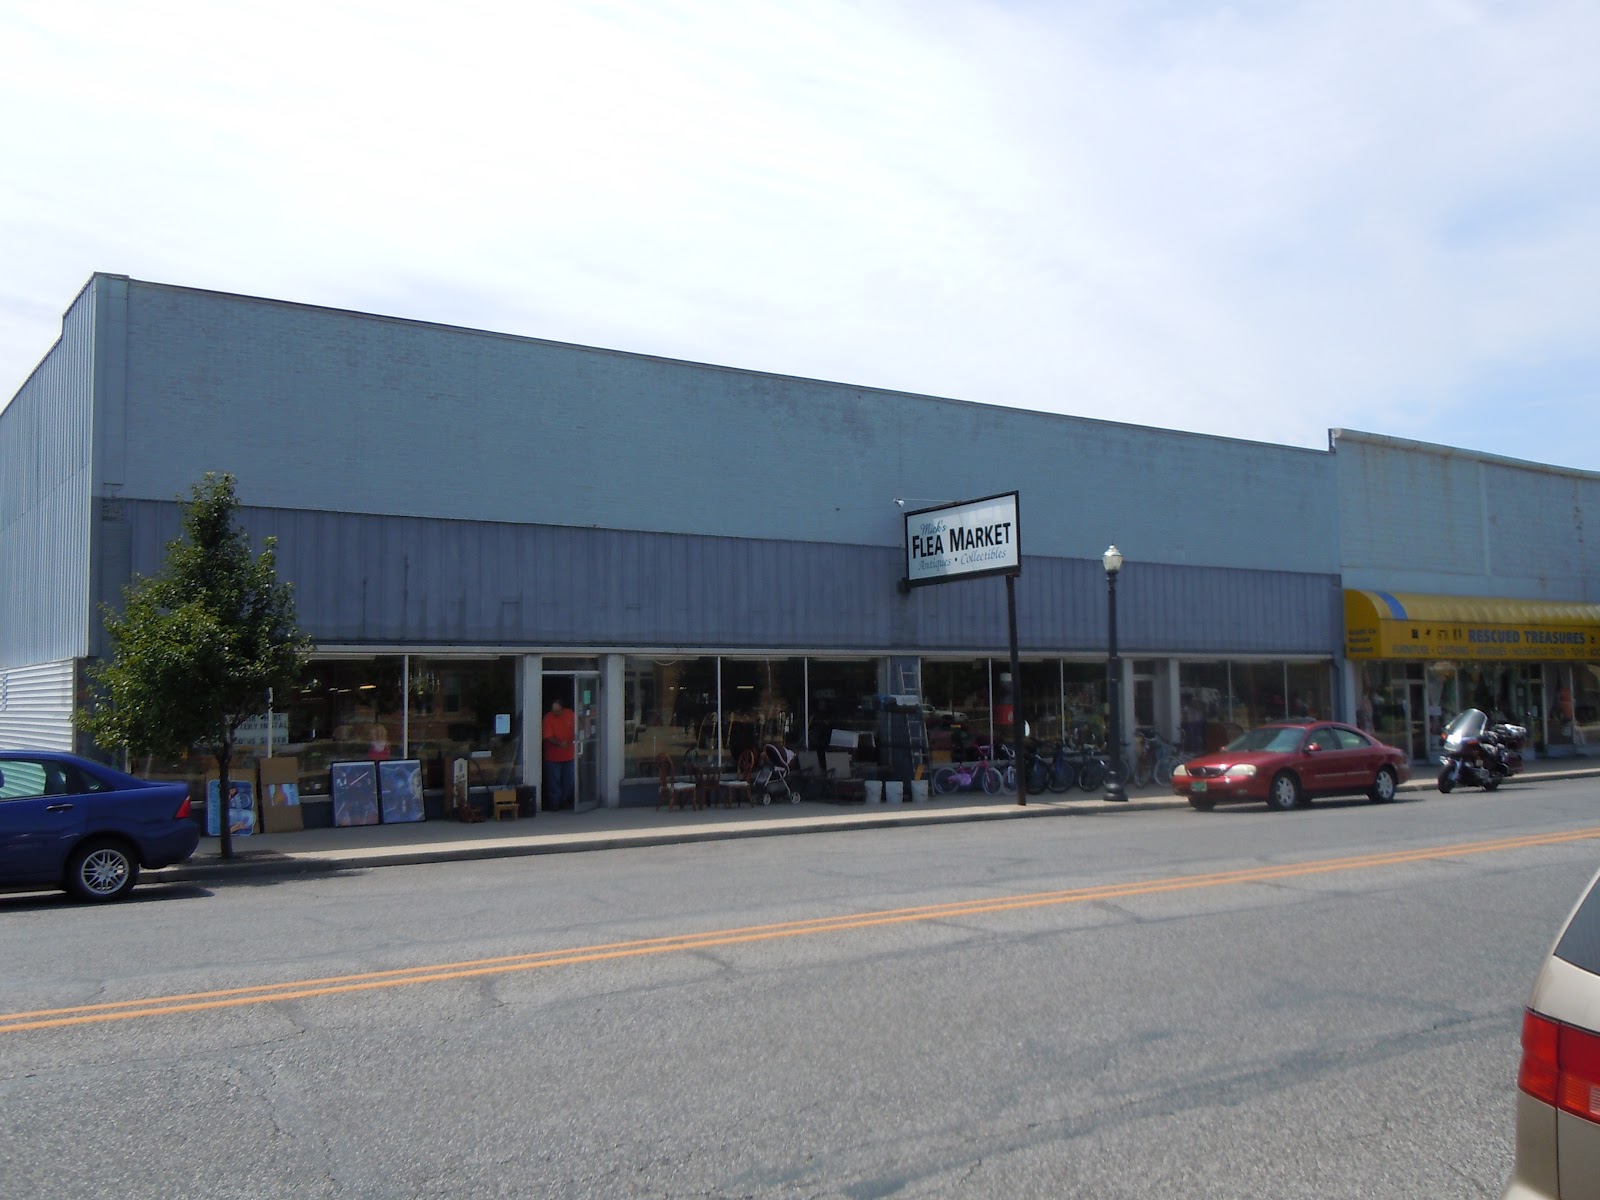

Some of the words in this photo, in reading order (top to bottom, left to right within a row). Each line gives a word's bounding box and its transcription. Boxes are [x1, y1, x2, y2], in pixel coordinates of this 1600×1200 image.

[920, 520, 946, 536] Mick's
[912, 534, 944, 559] FLEA
[949, 522, 1011, 552] MARKET
[918, 558, 952, 571] Antiques
[960, 547, 1007, 565] Collectibles
[1469, 629, 1520, 643] RESCUED
[1524, 630, 1586, 644] TREASURES
[1393, 645, 1429, 655] FURNITURE
[260, 736, 287, 744] SIVER
